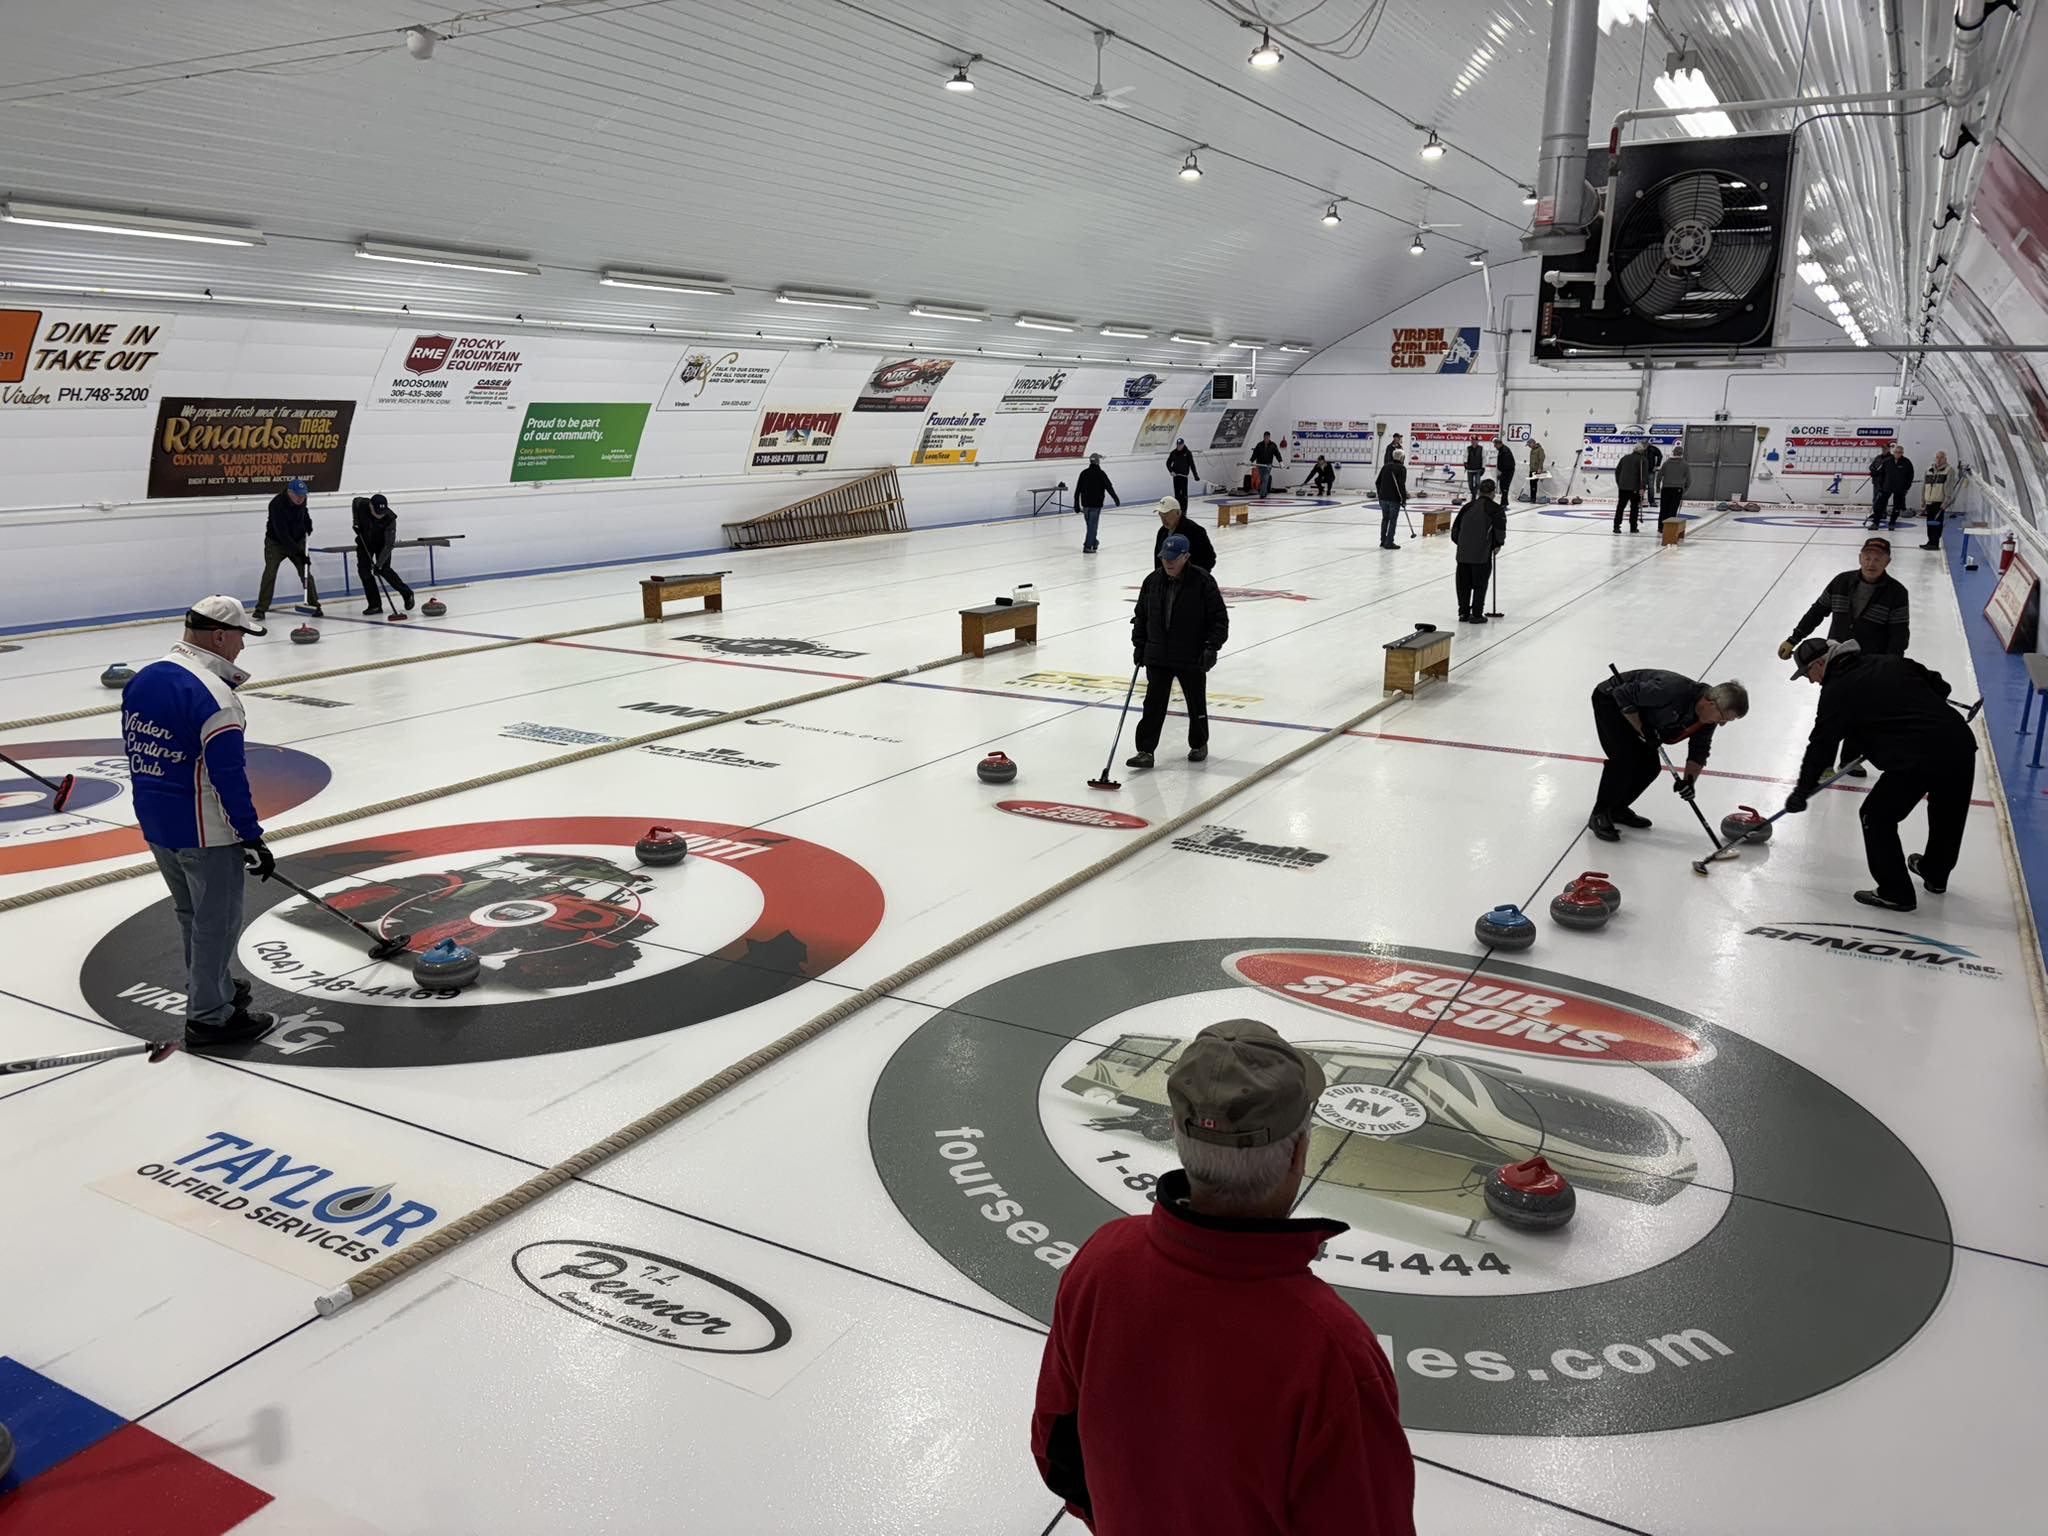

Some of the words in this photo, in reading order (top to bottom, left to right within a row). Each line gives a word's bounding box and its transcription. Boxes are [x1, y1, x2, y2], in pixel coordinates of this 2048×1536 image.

[44, 322, 118, 345] DINE
[123, 325, 160, 345] IN
[1392, 328, 1444, 341] VIRDEN
[457, 338, 506, 349] ROCKY
[1391, 341, 1448, 354] CURLING
[34, 349, 106, 371] TAKE
[105, 351, 159, 372] OUT
[411, 347, 446, 360] RME
[452, 349, 520, 361] MOUNTAIN
[1391, 355, 1426, 368] CLUB
[447, 360, 522, 373] EQUIPMENT
[392, 379, 448, 388] MOOSOMIN
[882, 369, 917, 382] NRG
[1014, 379, 1050, 389] VIRDEN
[2, 386, 50, 404] Virden
[181, 405, 195, 417] We
[193, 407, 231, 421] prepare
[231, 405, 253, 418] fresh
[256, 408, 276, 418] meat
[926, 411, 969, 426] Fountain
[970, 412, 987, 426] Tire
[527, 417, 556, 429] Proud
[557, 418, 566, 428] to
[569, 417, 580, 428] be
[580, 418, 601, 430] part
[760, 412, 842, 437] WARKENTIN
[1511, 426, 1522, 438] if
[1801, 426, 1829, 435] CORE
[162, 418, 288, 453] Renards
[299, 418, 331, 433] meat
[284, 434, 338, 449] services
[523, 430, 534, 441] of
[536, 431, 551, 440] our
[553, 429, 603, 442] community.
[173, 454, 215, 466] CUSTOM
[224, 465, 282, 477] WRAPPING
[124, 710, 173, 740] Virden
[127, 731, 187, 763] Curling
[642, 744, 781, 768] KEYSTONE
[131, 754, 165, 776] Club
[1010, 806, 1126, 827] SEASONS
[1048, 805, 1113, 817] FOUR
[1221, 847, 1315, 867] CONSTRUCTION
[1744, 926, 1963, 966] RFNOW
[1958, 962, 2003, 975] INC.
[253, 940, 300, 976] (204)
[300, 970, 462, 1000] 748-4469
[1376, 970, 1567, 1017] FOUR
[1284, 975, 1627, 1053] SEASONS
[1325, 1086, 1364, 1099] FOUR
[1370, 1087, 1421, 1118] SEASONS
[1318, 1103, 1410, 1132] SUPERSTORE
[173, 1131, 438, 1248] TAYLOR
[136, 1163, 249, 1211] OILFIELD
[244, 1206, 380, 1263] SERVICES
[541, 1251, 731, 1335] Penner
